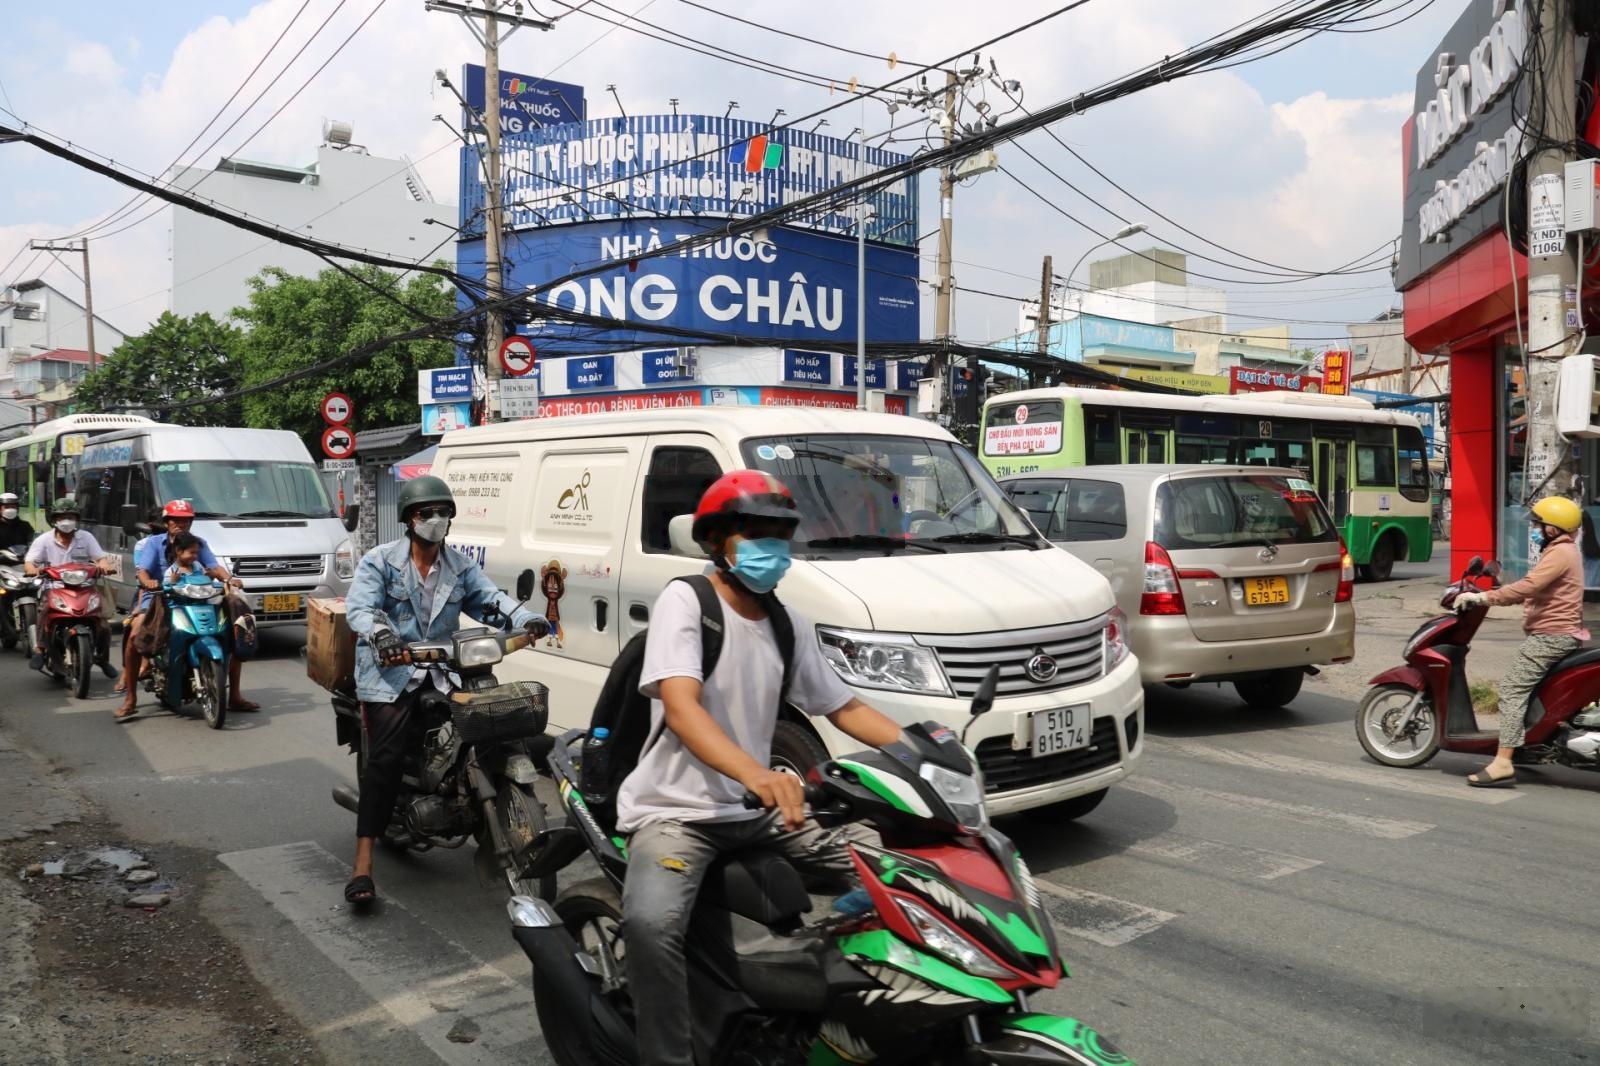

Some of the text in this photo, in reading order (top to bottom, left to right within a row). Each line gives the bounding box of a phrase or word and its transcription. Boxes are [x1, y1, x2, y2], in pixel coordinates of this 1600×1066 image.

[521, 102, 561, 118] THUỐC
[535, 143, 562, 172] TY
[643, 122, 719, 163] PHẨM
[789, 145, 824, 178] FPT
[660, 171, 726, 199] thuốc
[1541, 229, 1563, 240] NDT
[601, 227, 666, 261] NHÀ
[699, 271, 843, 332] CHÂU
[583, 361, 598, 370] GAN
[807, 355, 820, 367] HẤP
[437, 373, 466, 383] TIM MẠCH
[577, 375, 588, 384] DẠ
[555, 402, 583, 417] THEO
[586, 401, 607, 415] TOA
[610, 396, 638, 412] BỆNH
[669, 393, 693, 407] LỚN
[1017, 407, 1027, 421] 29
[1025, 425, 1043, 437] NÔNG
[1261, 422, 1271, 437] 29
[1256, 578, 1275, 591] 51F
[1250, 590, 1285, 604] 679.75
[1047, 709, 1073, 731] 51D
[1038, 727, 1084, 753] 815.74
[574, 800, 607, 841] WINNER
